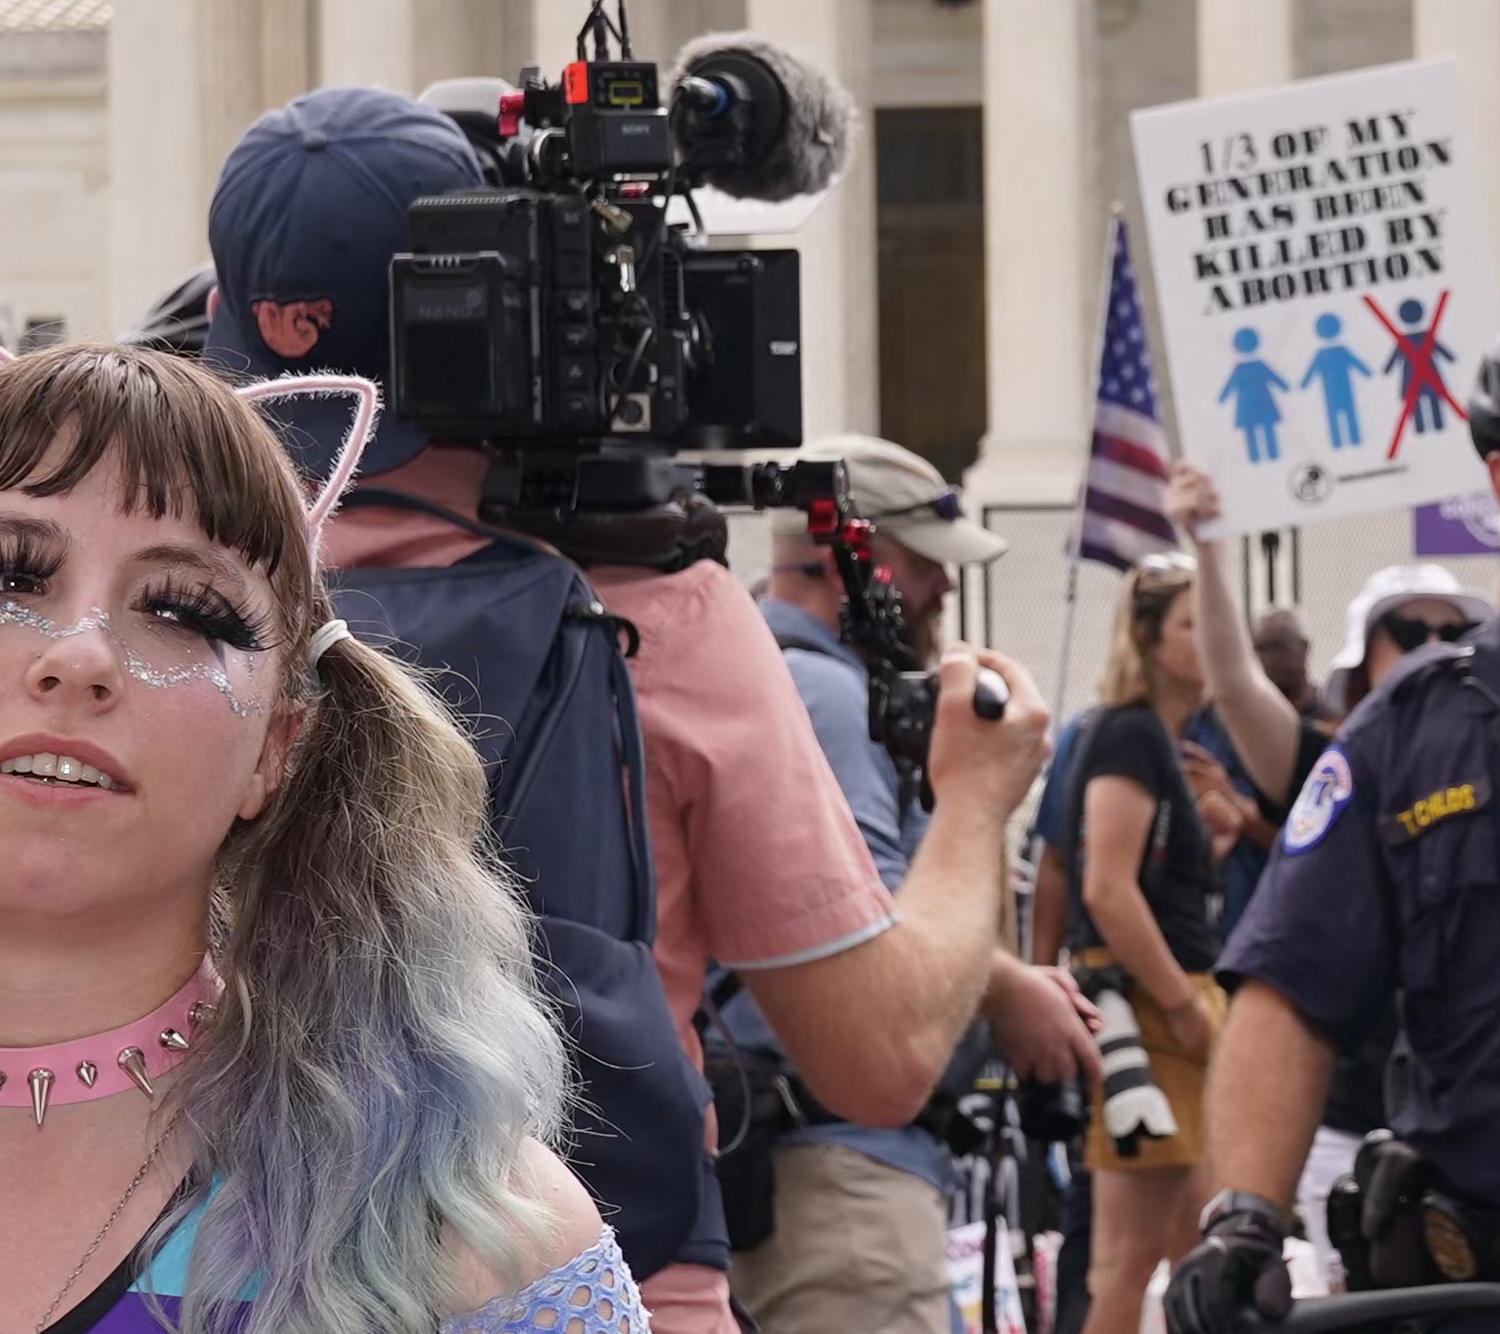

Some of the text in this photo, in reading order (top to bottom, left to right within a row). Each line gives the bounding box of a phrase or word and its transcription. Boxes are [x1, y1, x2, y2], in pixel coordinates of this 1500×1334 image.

[1272, 127, 1327, 160] OF
[1346, 112, 1415, 145] MY
[1166, 139, 1452, 213] GENERATION
[1204, 181, 1428, 241] HAS BEEN
[1193, 210, 1448, 280] KILLED BY
[1201, 248, 1444, 315] ABORTION
